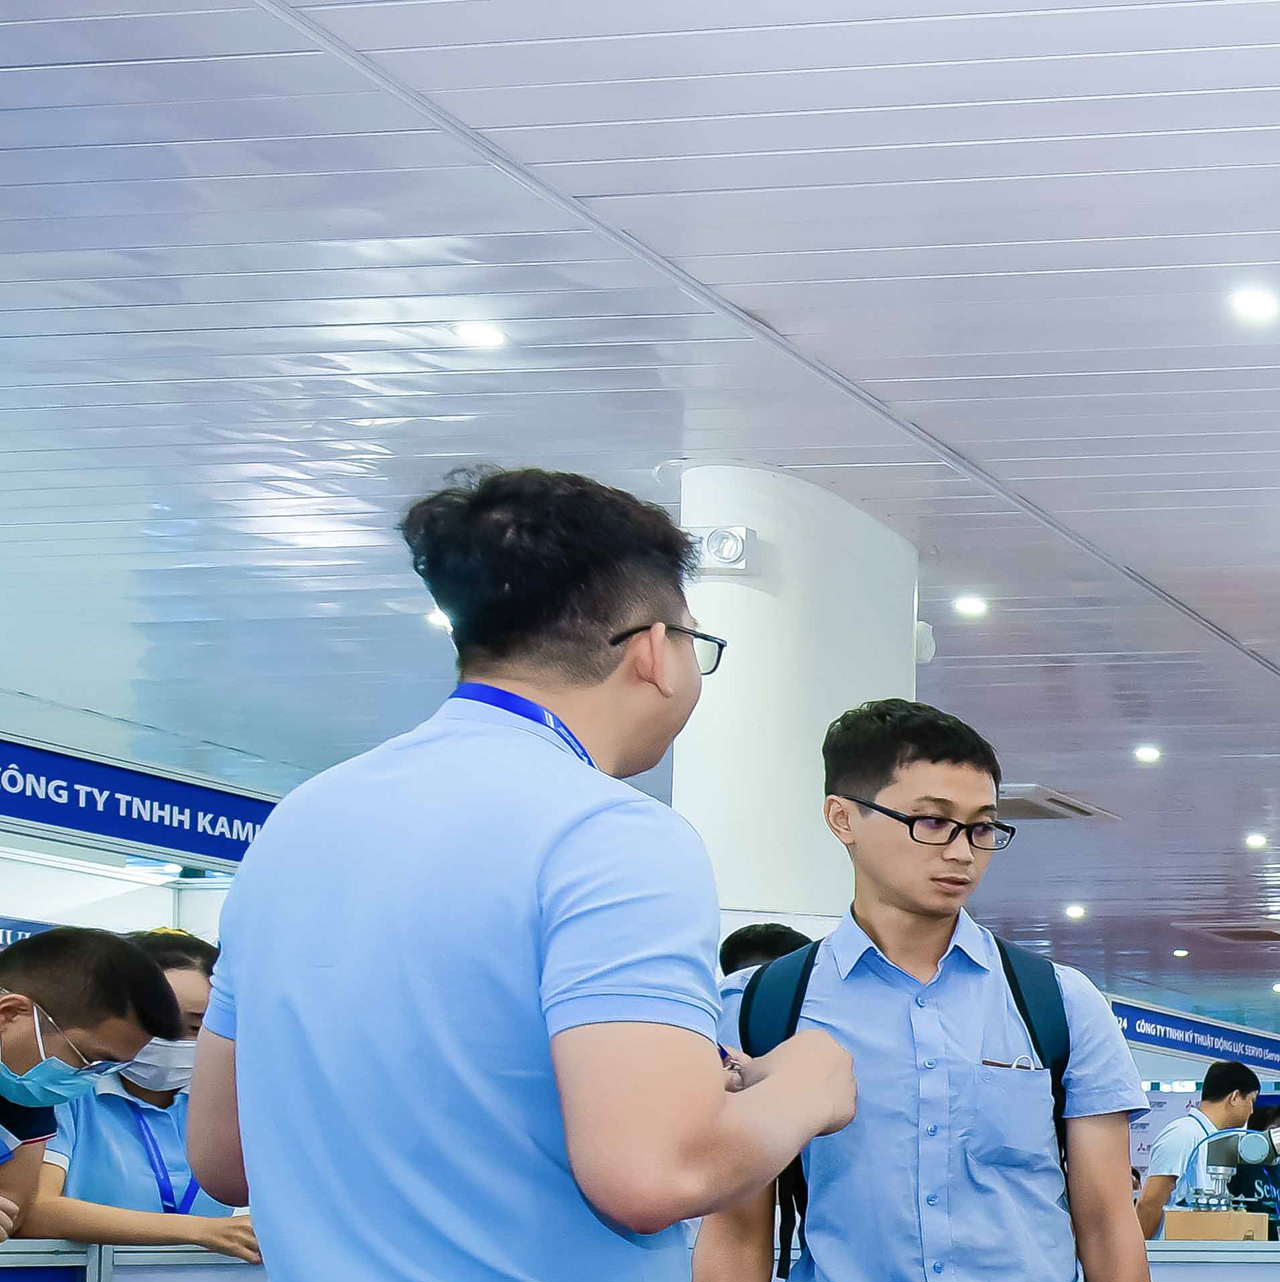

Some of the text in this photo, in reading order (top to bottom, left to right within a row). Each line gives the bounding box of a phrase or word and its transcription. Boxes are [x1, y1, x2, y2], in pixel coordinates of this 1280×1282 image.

[0, 763, 69, 804] ÔNG
[74, 784, 110, 811] TY
[115, 793, 190, 829] TNHH
[1135, 1019, 1156, 1034] CÔNG
[1156, 1027, 1166, 1038] TY
[1166, 1029, 1185, 1041] TNHH
